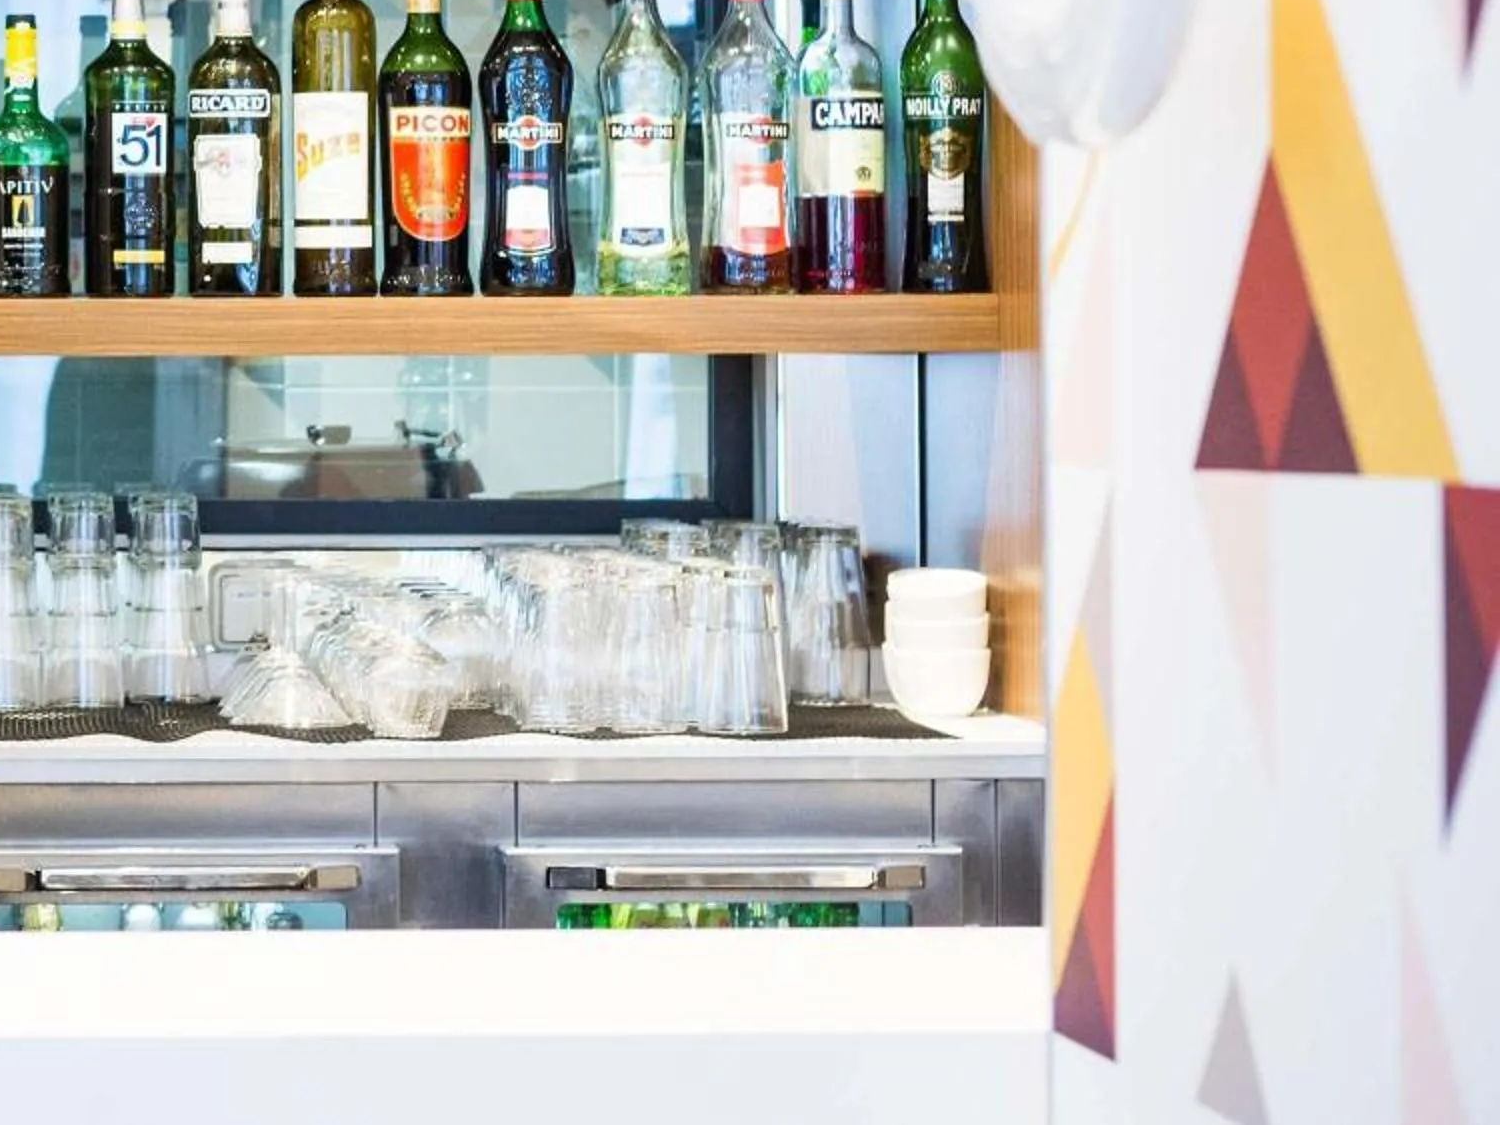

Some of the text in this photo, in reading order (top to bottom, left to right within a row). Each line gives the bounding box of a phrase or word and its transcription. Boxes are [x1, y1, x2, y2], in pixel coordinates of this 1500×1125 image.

[190, 95, 266, 113] RICARD
[814, 101, 885, 126] CAMPA
[905, 97, 951, 116] NOILLY
[396, 114, 470, 133] PICON
[610, 125, 673, 138] MARTINI
[728, 124, 788, 138] MARTINI
[120, 124, 162, 167] 51
